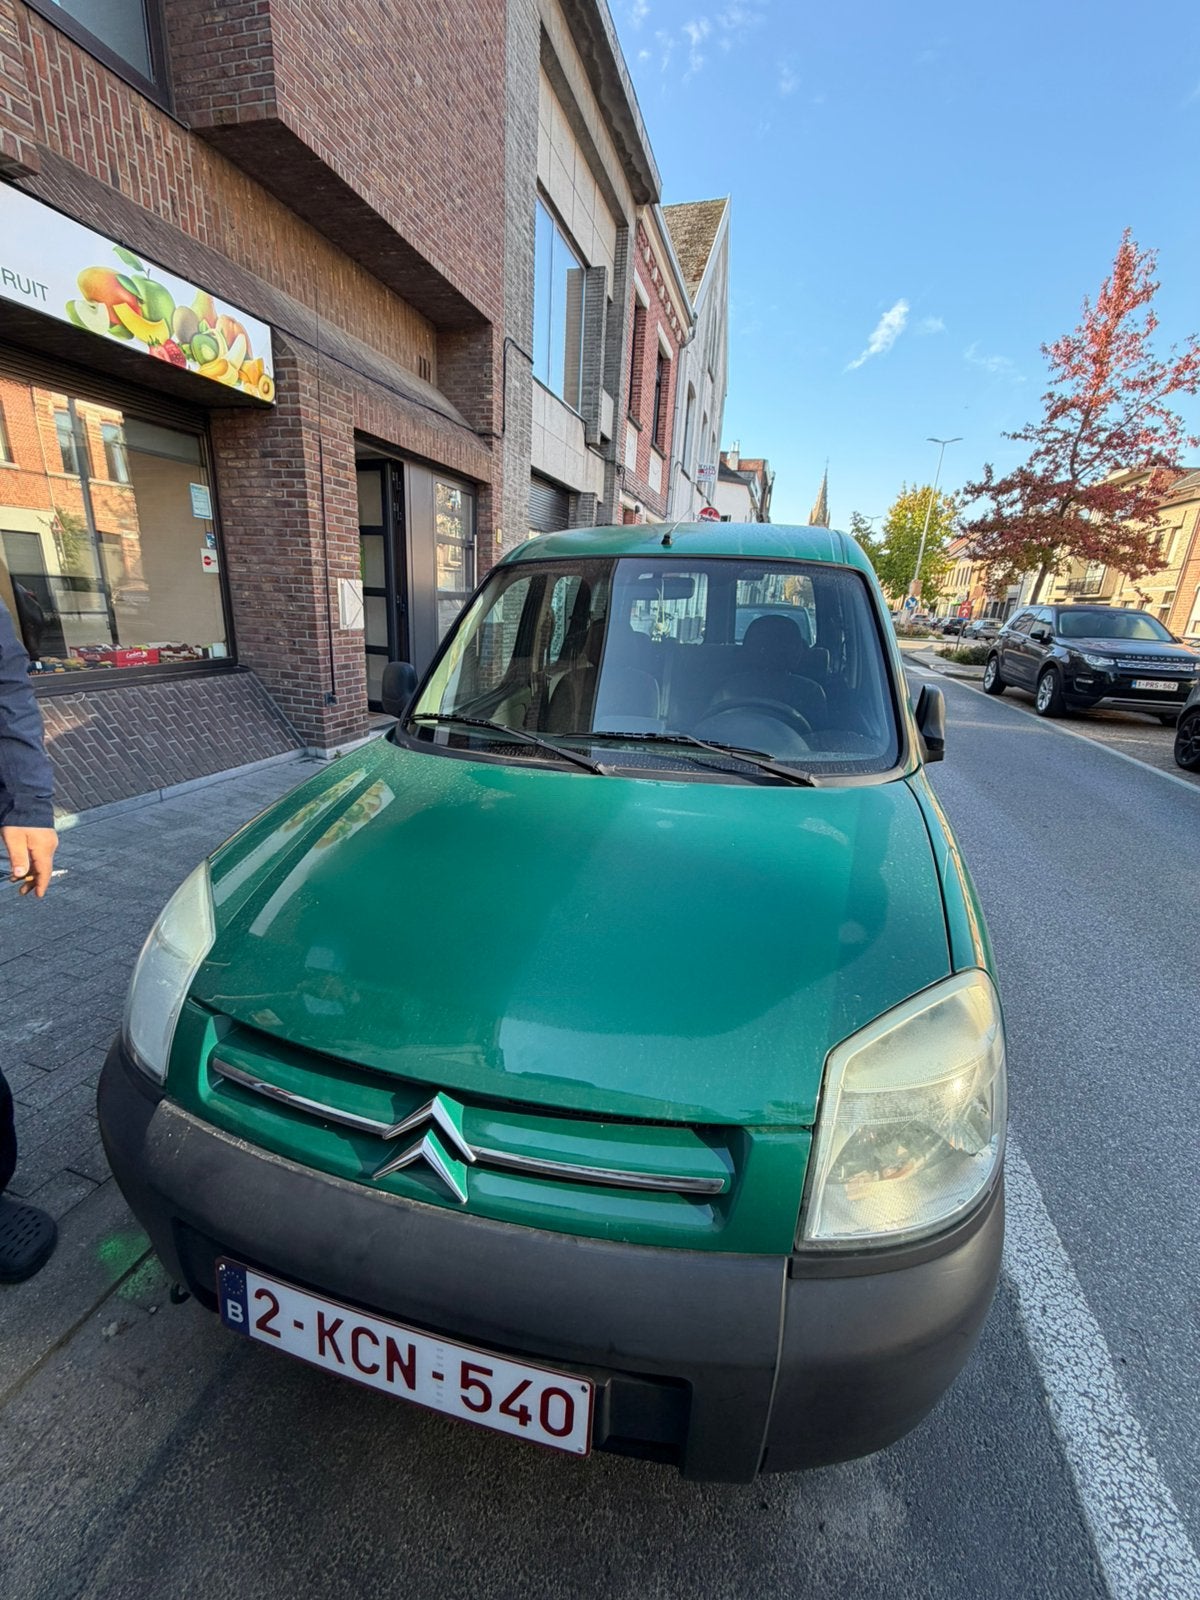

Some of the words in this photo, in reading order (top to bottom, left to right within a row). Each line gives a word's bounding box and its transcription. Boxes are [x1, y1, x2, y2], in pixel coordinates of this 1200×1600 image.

[1, 267, 48, 301] RUIT
[227, 1299, 244, 1323] B
[254, 1288, 575, 1438] 2-KCN-540
